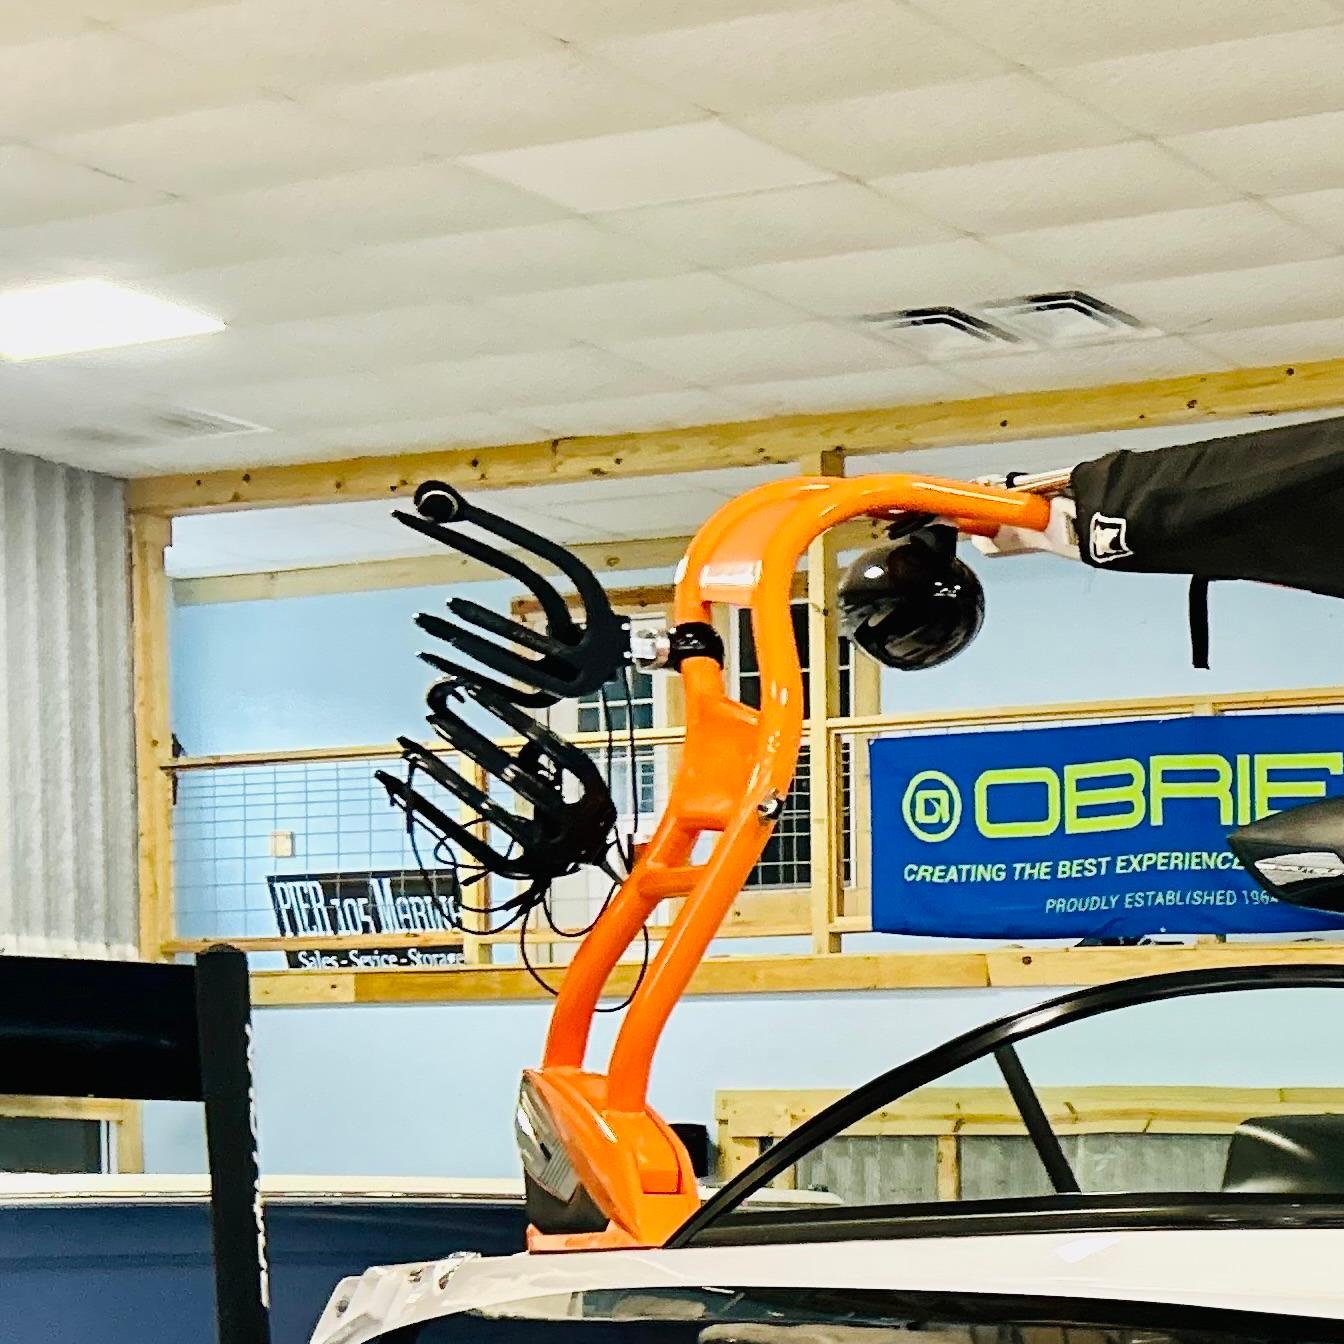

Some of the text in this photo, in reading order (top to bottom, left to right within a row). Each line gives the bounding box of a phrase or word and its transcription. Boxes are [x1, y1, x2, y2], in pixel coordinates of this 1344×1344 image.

[904, 863, 1007, 883] CREATING
[1013, 861, 1053, 881] THE
[1057, 856, 1112, 879] BEST
[274, 880, 335, 938] PIER
[1045, 894, 1121, 914] PROUDLY
[1124, 890, 1237, 909] ESTABLISHED
[298, 949, 340, 968] Sales
